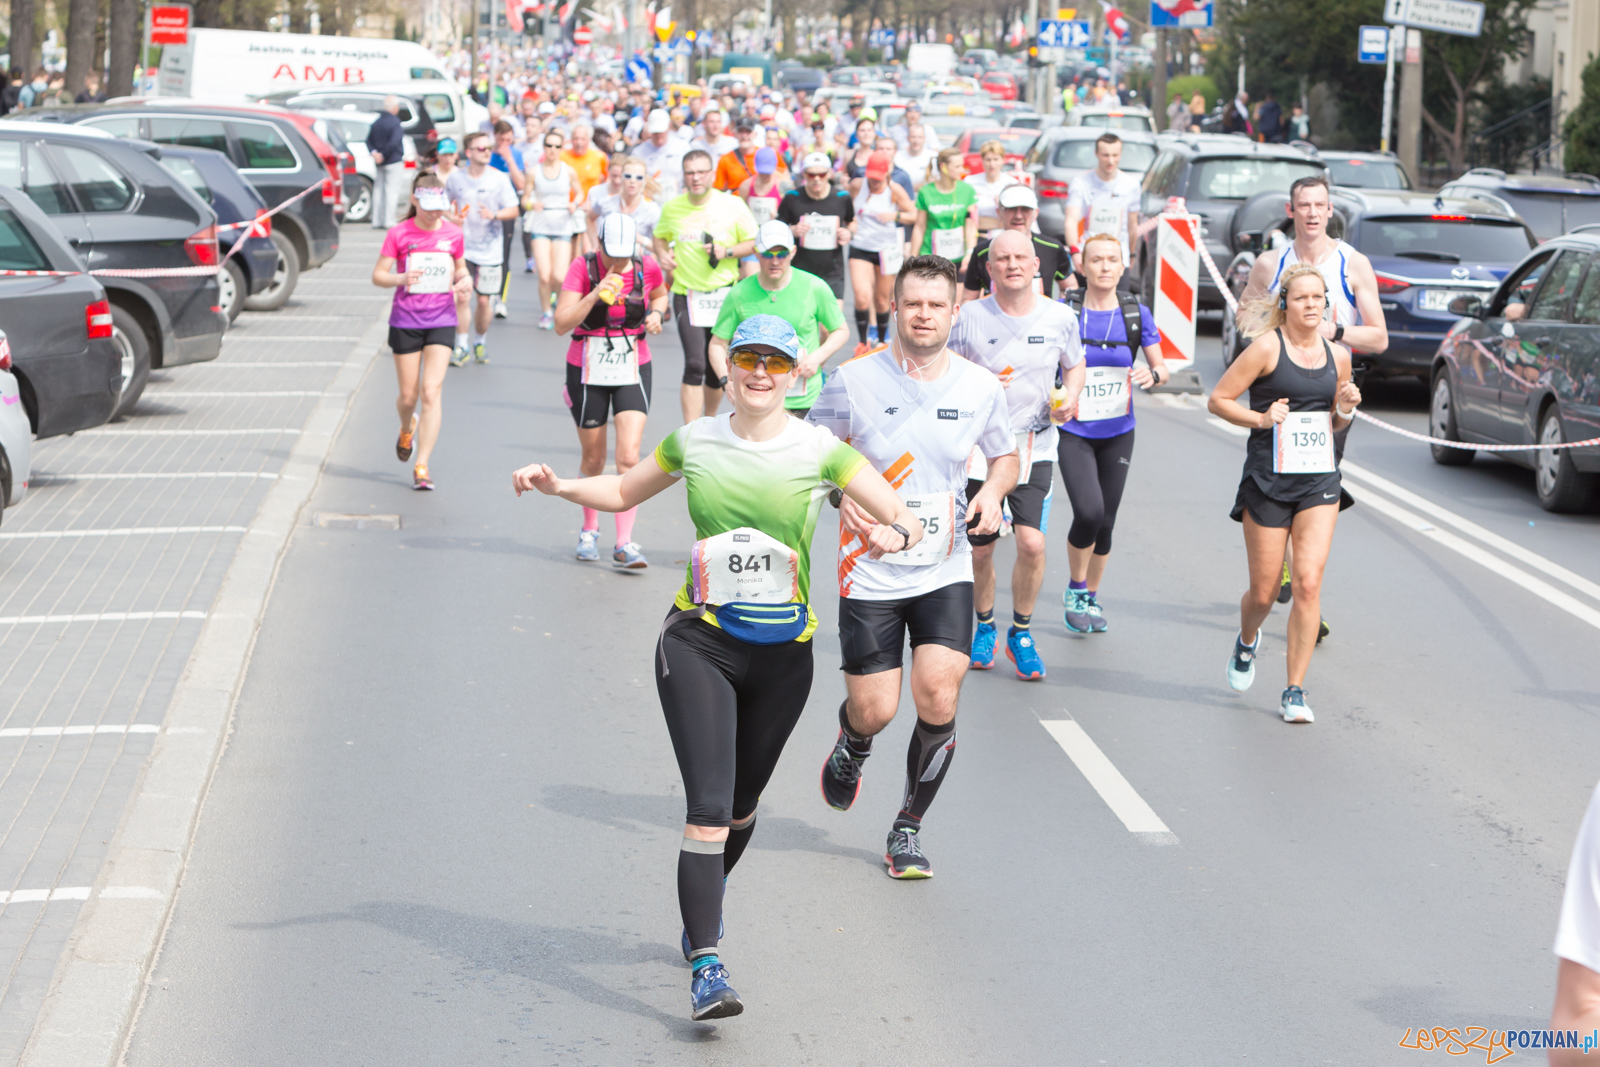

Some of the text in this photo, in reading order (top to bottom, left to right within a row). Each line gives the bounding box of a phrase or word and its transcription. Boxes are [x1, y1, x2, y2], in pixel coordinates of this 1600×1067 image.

[1411, 12, 1472, 29] Parkowania
[272, 64, 365, 83] AMB
[597, 353, 627, 364] 7471
[1083, 382, 1122, 397] 11577
[1291, 432, 1326, 447] 1390
[728, 553, 771, 574] 841
